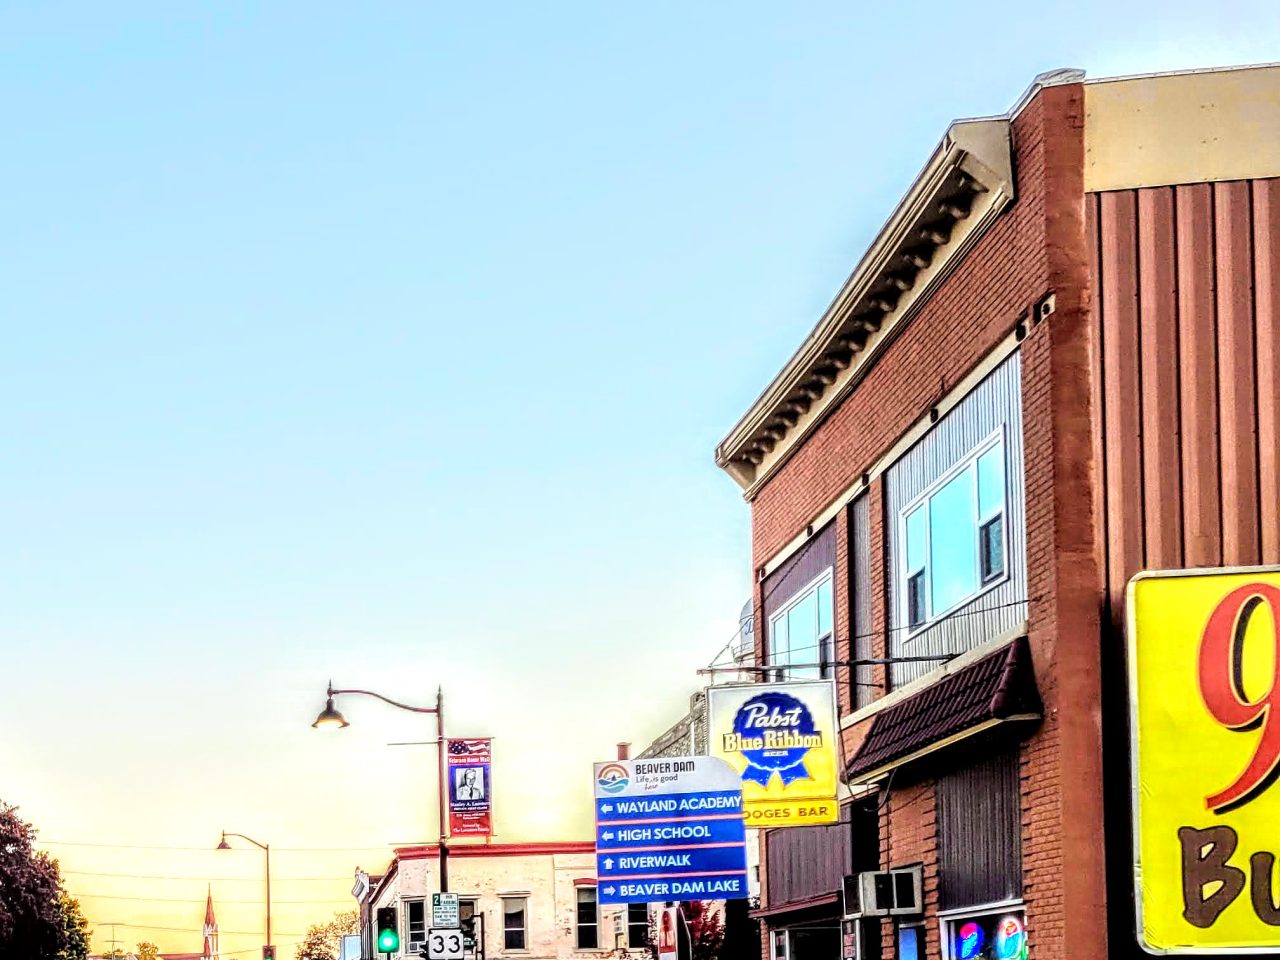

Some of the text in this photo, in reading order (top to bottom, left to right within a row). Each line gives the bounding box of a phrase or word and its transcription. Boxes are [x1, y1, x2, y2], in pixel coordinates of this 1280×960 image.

[1196, 582, 1280, 816] 9
[743, 702, 802, 729] Pabst
[723, 729, 821, 752] Blue Ribbon
[635, 761, 695, 775] BEAVER DAM
[636, 775, 650, 783] Life
[660, 774, 679, 783] good
[616, 796, 741, 814] WAYLAND ACADEMY
[798, 806, 829, 817] BAR
[618, 826, 711, 841] HIGH SCHOOL
[620, 855, 691, 869] RIVERWALK
[620, 880, 739, 896] BEAVER DAM LAKE
[434, 895, 440, 905] 2
[433, 935, 460, 953] 33
